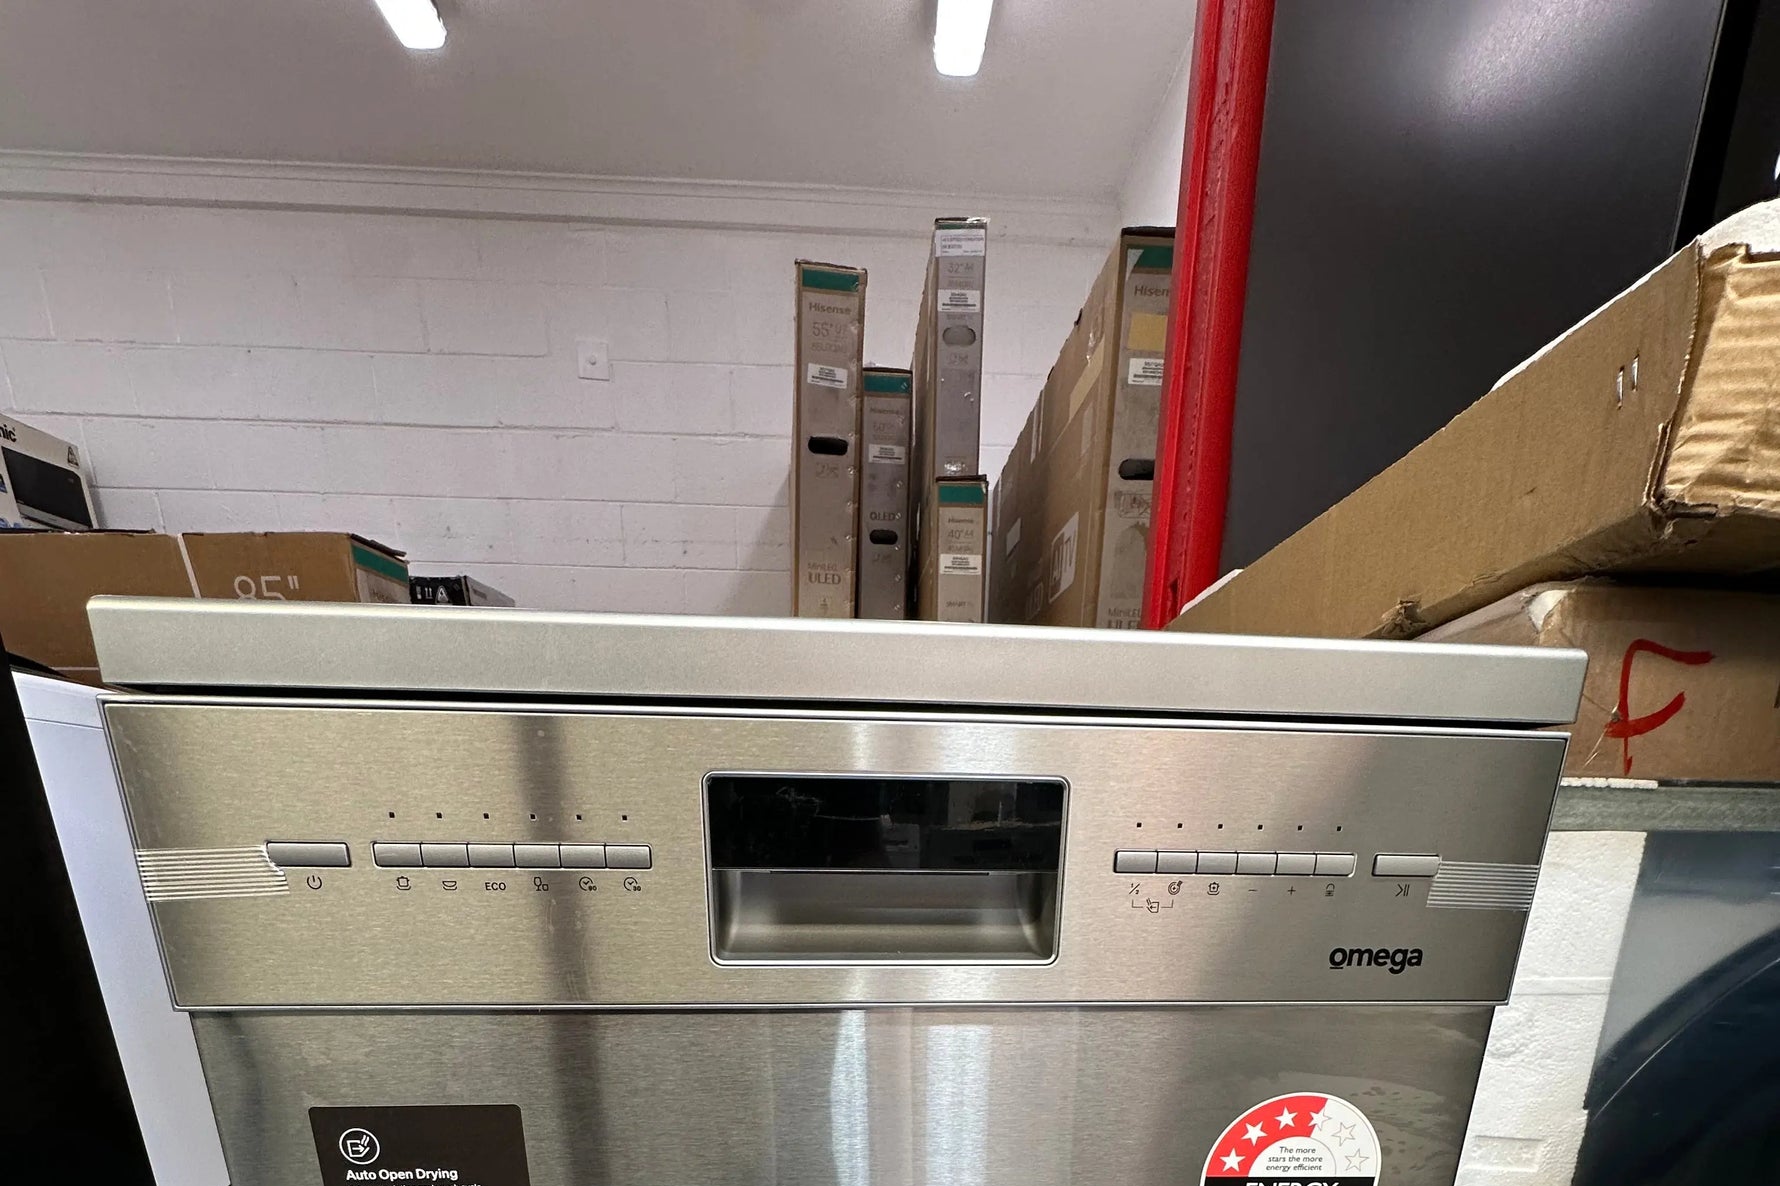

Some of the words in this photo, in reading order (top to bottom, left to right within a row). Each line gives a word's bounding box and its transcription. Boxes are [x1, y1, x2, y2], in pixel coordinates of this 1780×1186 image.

[809, 302, 852, 315] Hisense
[807, 572, 841, 585] ULED
[485, 881, 507, 891] ECO
[1329, 947, 1423, 974] omega
[1280, 1146, 1293, 1154] The
[346, 1170, 376, 1180] Auto
[378, 1169, 413, 1181] Open
[415, 1168, 458, 1181] Drying
